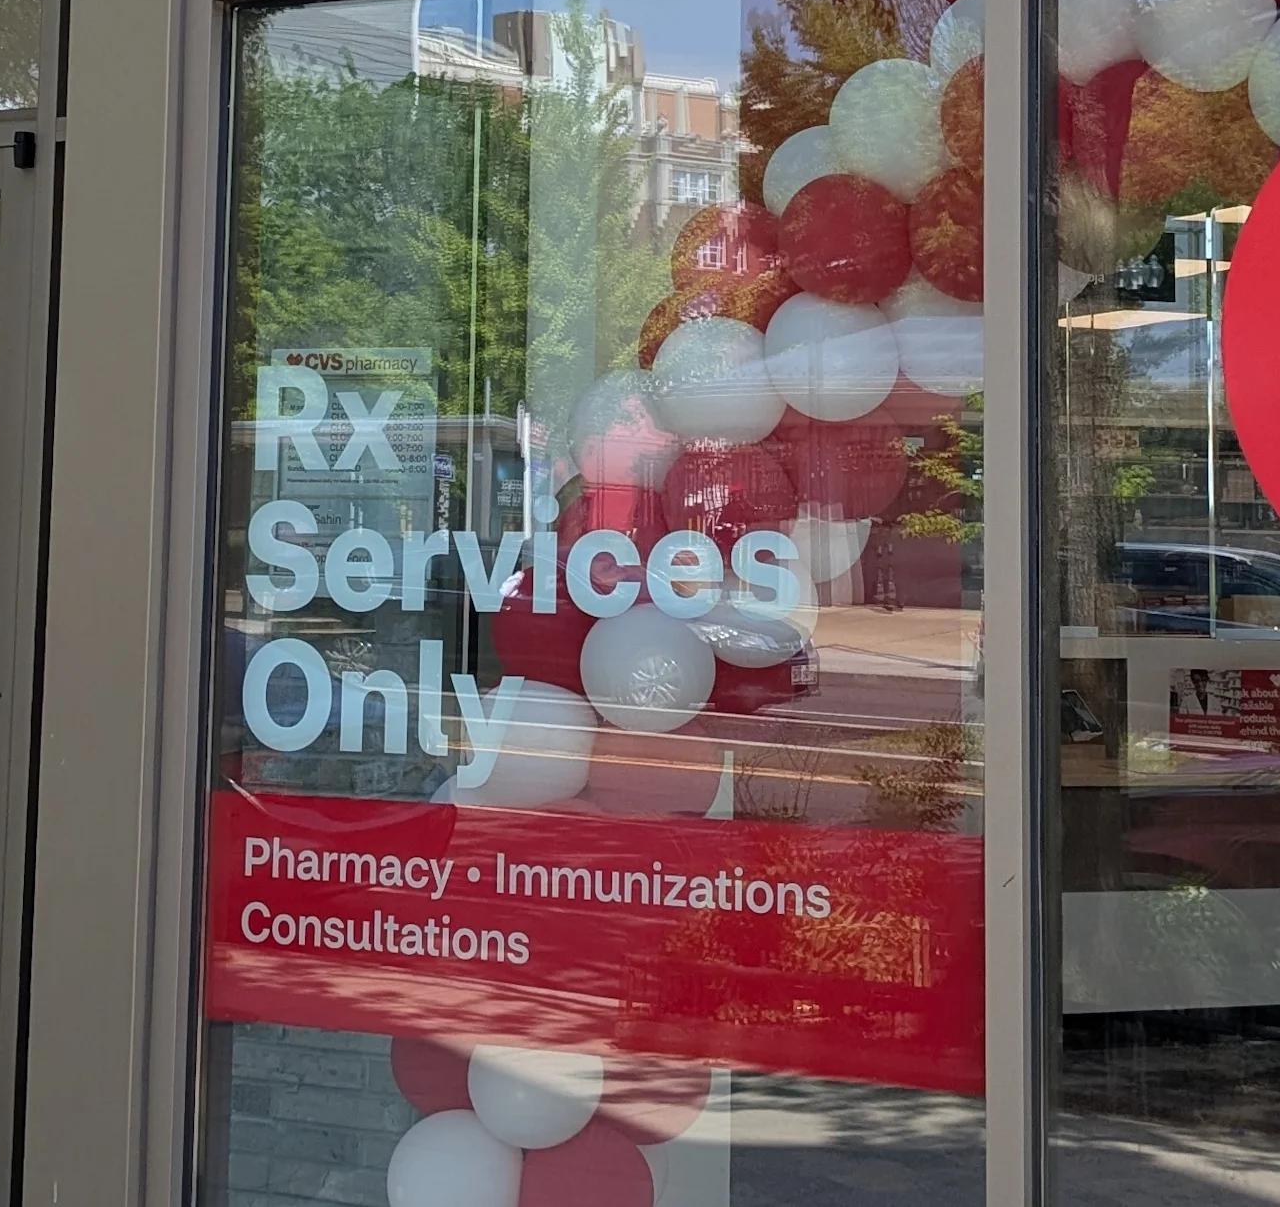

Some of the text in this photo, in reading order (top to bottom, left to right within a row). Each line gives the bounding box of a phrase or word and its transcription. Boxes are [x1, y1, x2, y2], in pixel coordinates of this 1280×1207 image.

[304, 353, 417, 373] CVS pharmacy
[254, 365, 405, 471] Rx
[246, 496, 802, 619] Services
[242, 639, 525, 789] Only
[1240, 714, 1277, 723] roducts
[1251, 688, 1279, 698] about
[1240, 726, 1268, 736] ehind
[243, 836, 832, 919] Pharmacy Immunizations
[240, 902, 530, 965] Consultations
